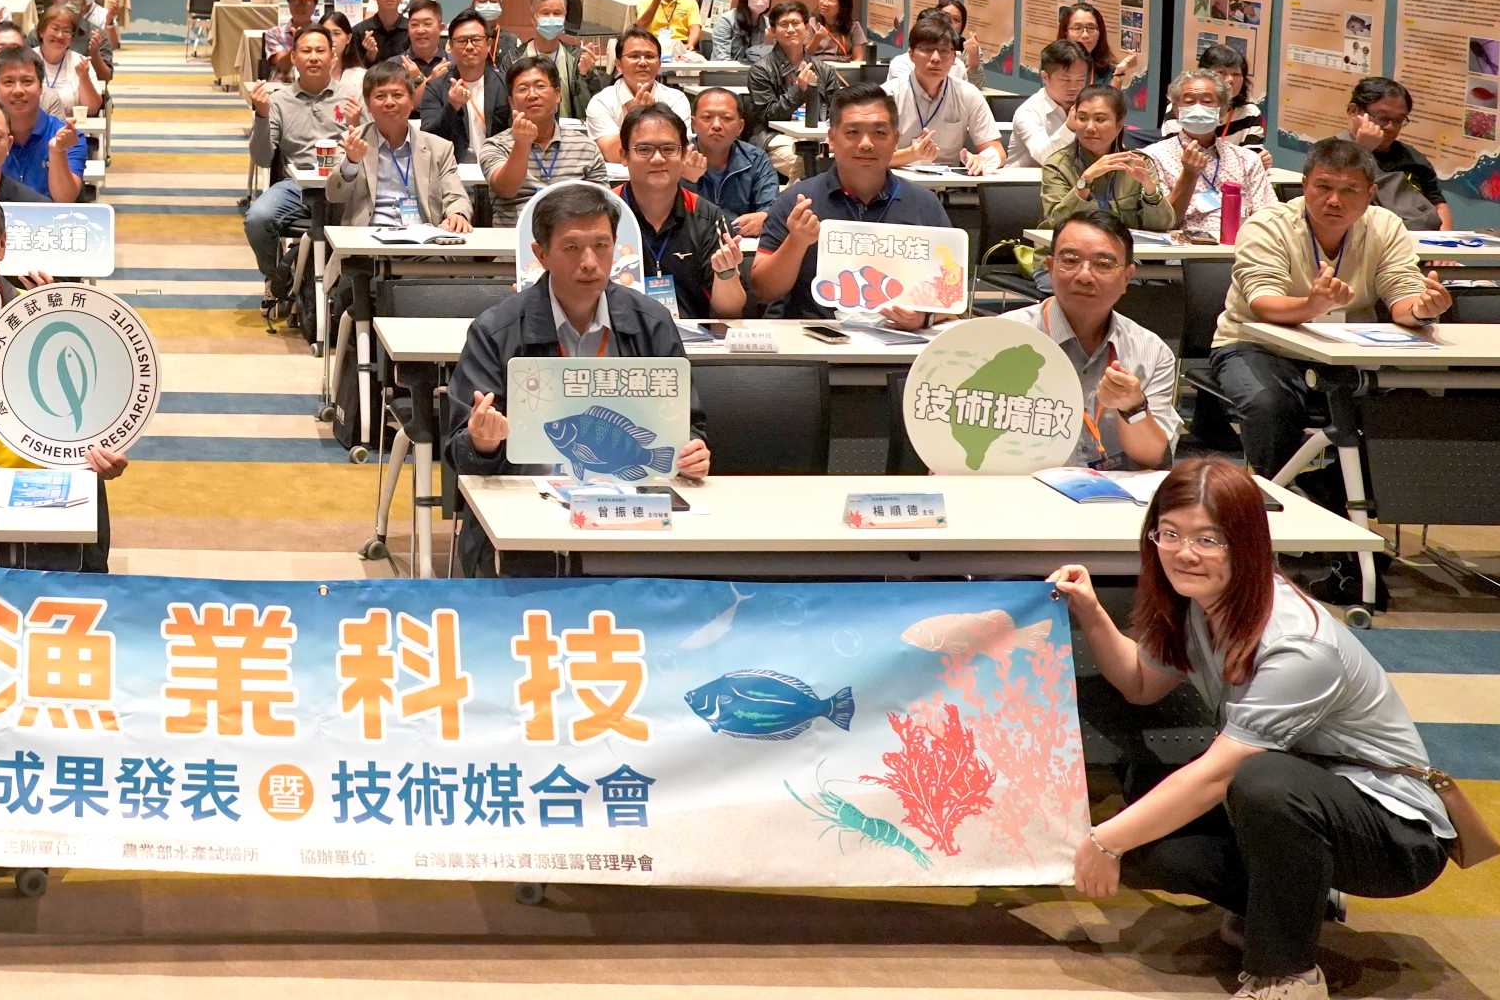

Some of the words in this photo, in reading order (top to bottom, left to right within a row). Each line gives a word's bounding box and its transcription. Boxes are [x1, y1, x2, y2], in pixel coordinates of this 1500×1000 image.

[827, 231, 931, 260] 觀賞水族
[108, 309, 151, 378] INSTITUTE
[563, 368, 678, 398] 智慧漁業
[914, 382, 1074, 440] 技術擴散
[100, 383, 151, 449] RESEARCH
